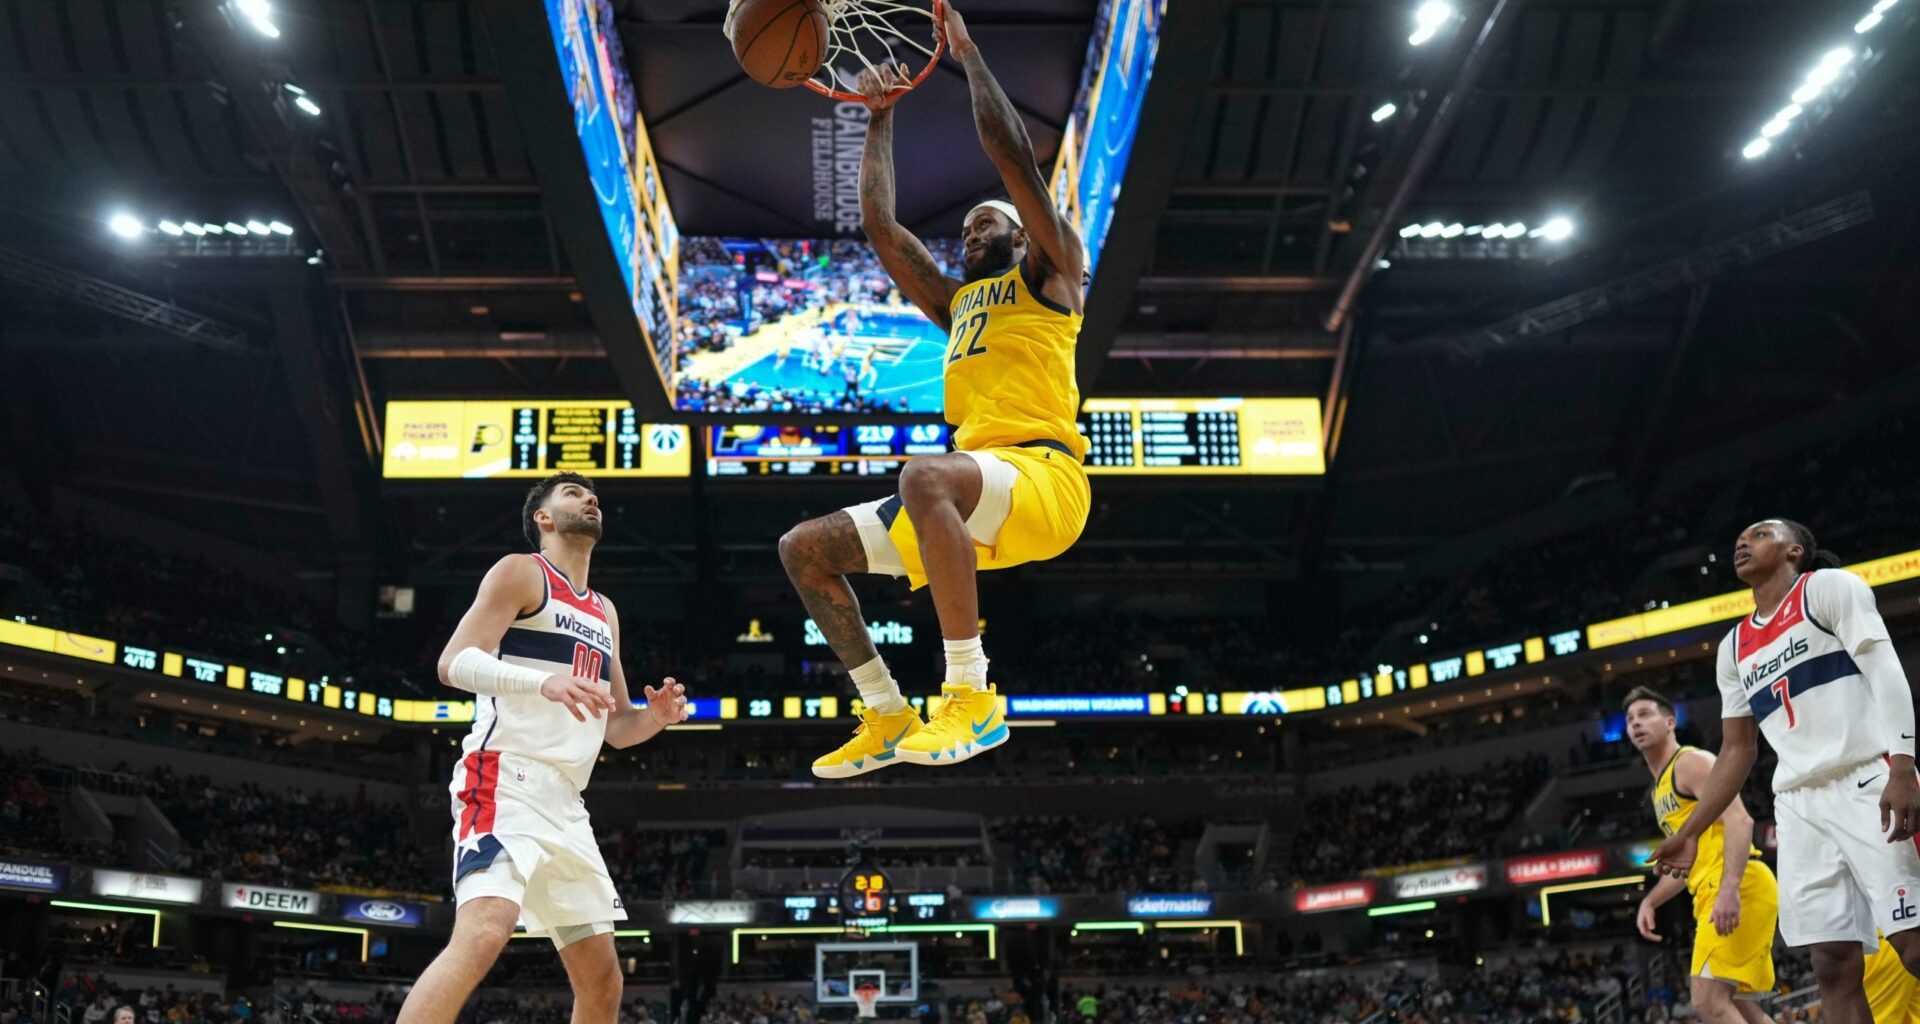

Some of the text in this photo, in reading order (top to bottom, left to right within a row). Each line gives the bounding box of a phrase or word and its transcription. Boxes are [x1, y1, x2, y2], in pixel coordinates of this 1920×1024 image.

[812, 118, 833, 221] FIELDHOUSE
[948, 311, 987, 363] 22
[910, 424, 941, 442] 6.9
[750, 700, 771, 716] 23
[1012, 697, 1144, 712] WASHINGTON WIZARDS
[1771, 675, 1796, 730] 7
[1397, 875, 1451, 894] KeyBank
[251, 890, 309, 911] DEEM
[1129, 897, 1212, 913] ticketmaster
